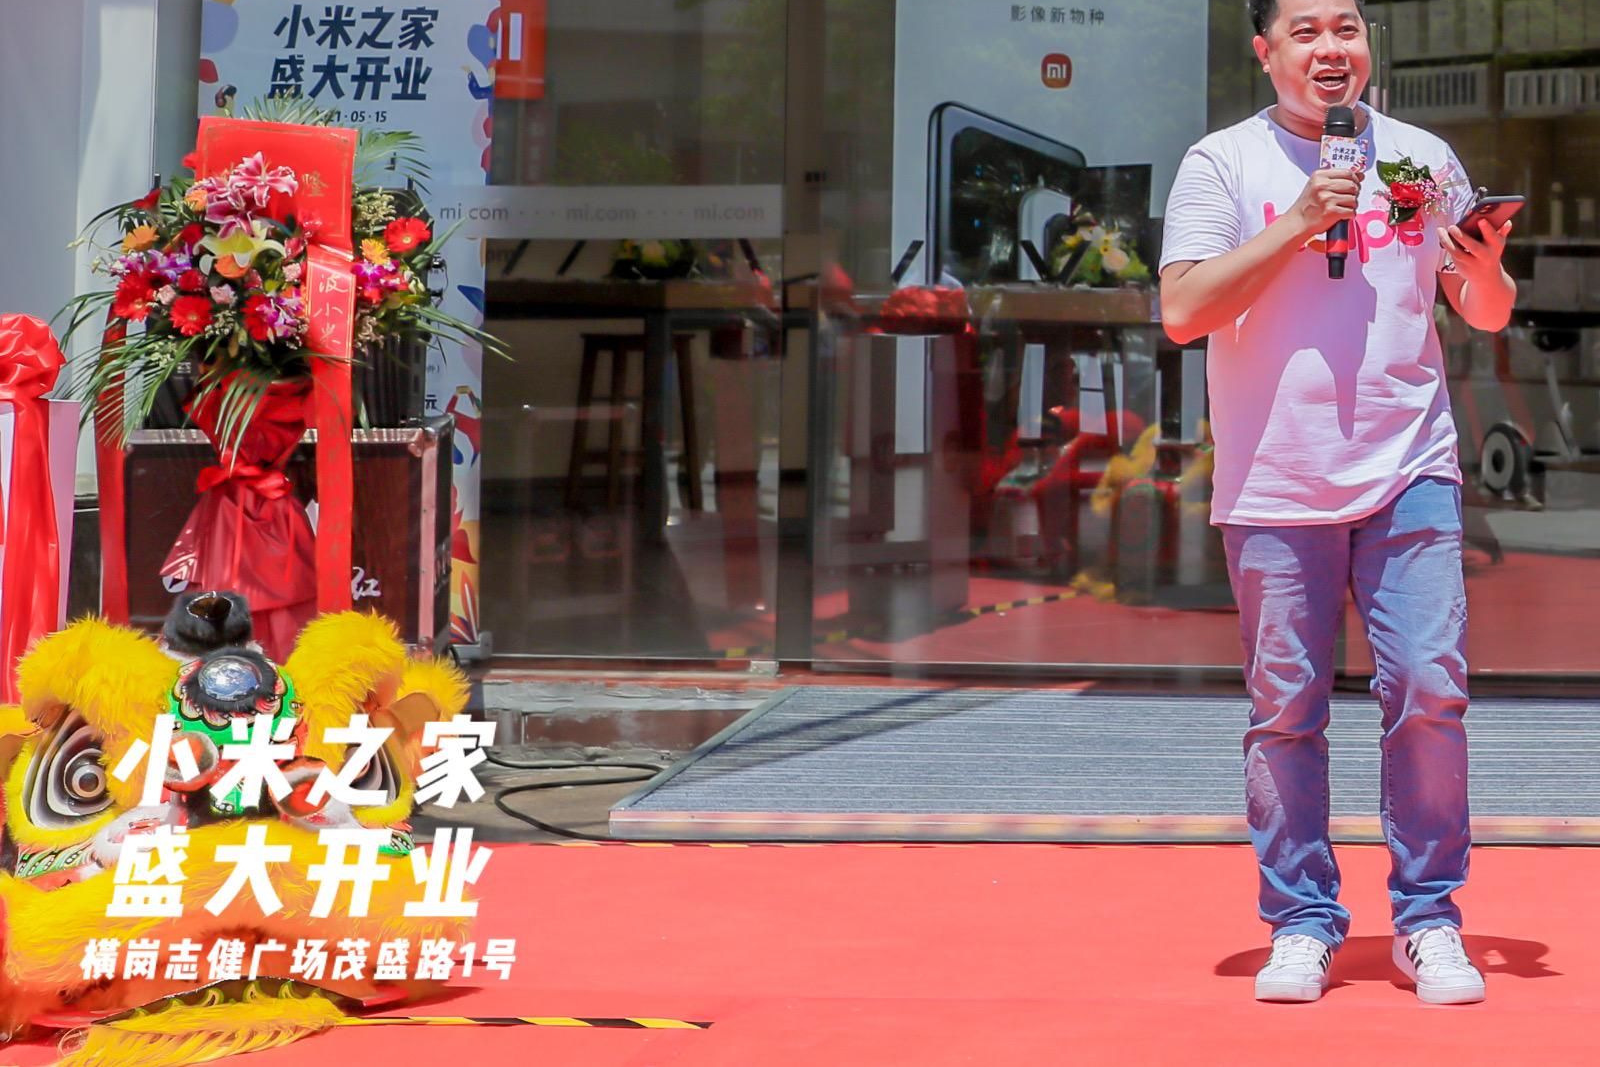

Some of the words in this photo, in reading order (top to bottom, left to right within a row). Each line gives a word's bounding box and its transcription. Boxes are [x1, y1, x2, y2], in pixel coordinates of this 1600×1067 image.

[273, 4, 439, 50] 小米之家
[1010, 5, 1105, 25] 影像新物种
[267, 55, 432, 101] 盛大开业
[439, 203, 510, 221] micom
[566, 204, 637, 222] mi.com
[693, 204, 766, 222] mi.com
